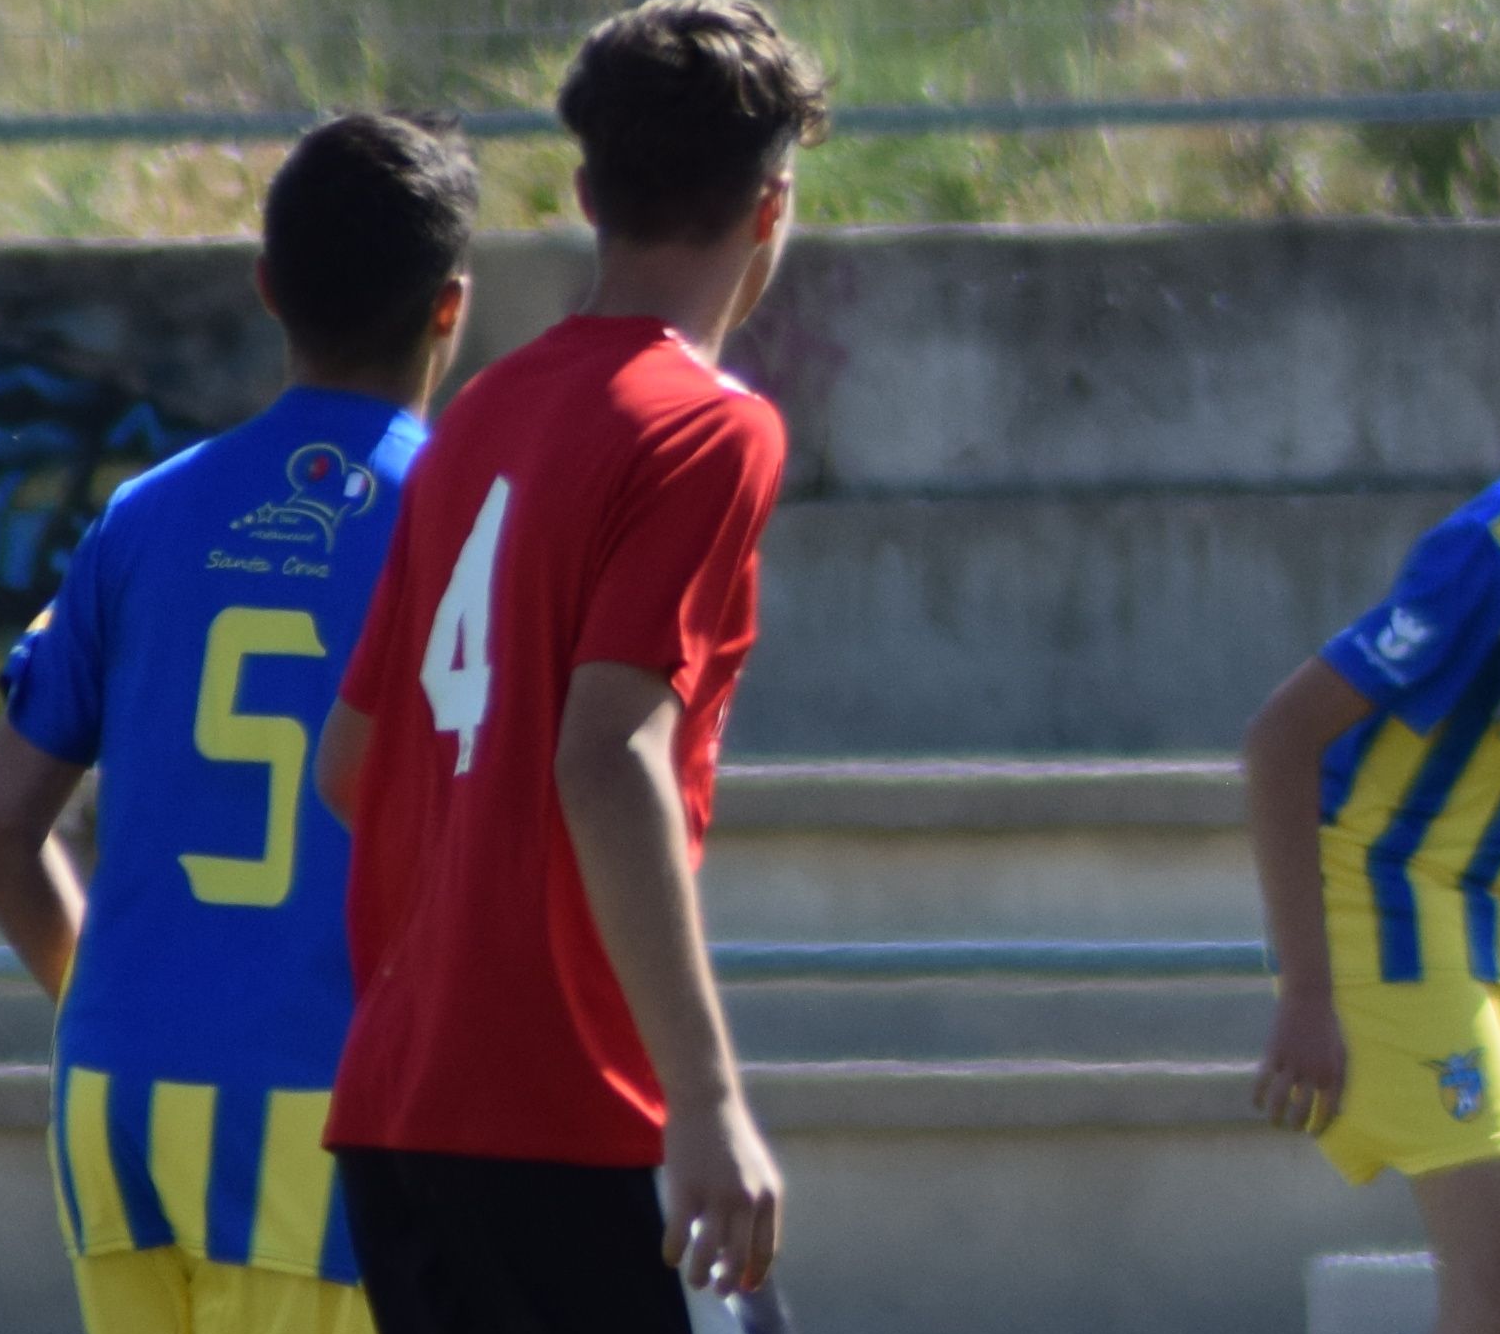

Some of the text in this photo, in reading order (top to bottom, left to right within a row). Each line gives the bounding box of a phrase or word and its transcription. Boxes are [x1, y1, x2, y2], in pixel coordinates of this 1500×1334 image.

[205, 549, 332, 578] Santa Cruz
[420, 474, 511, 776] 4
[179, 607, 326, 907] 5
